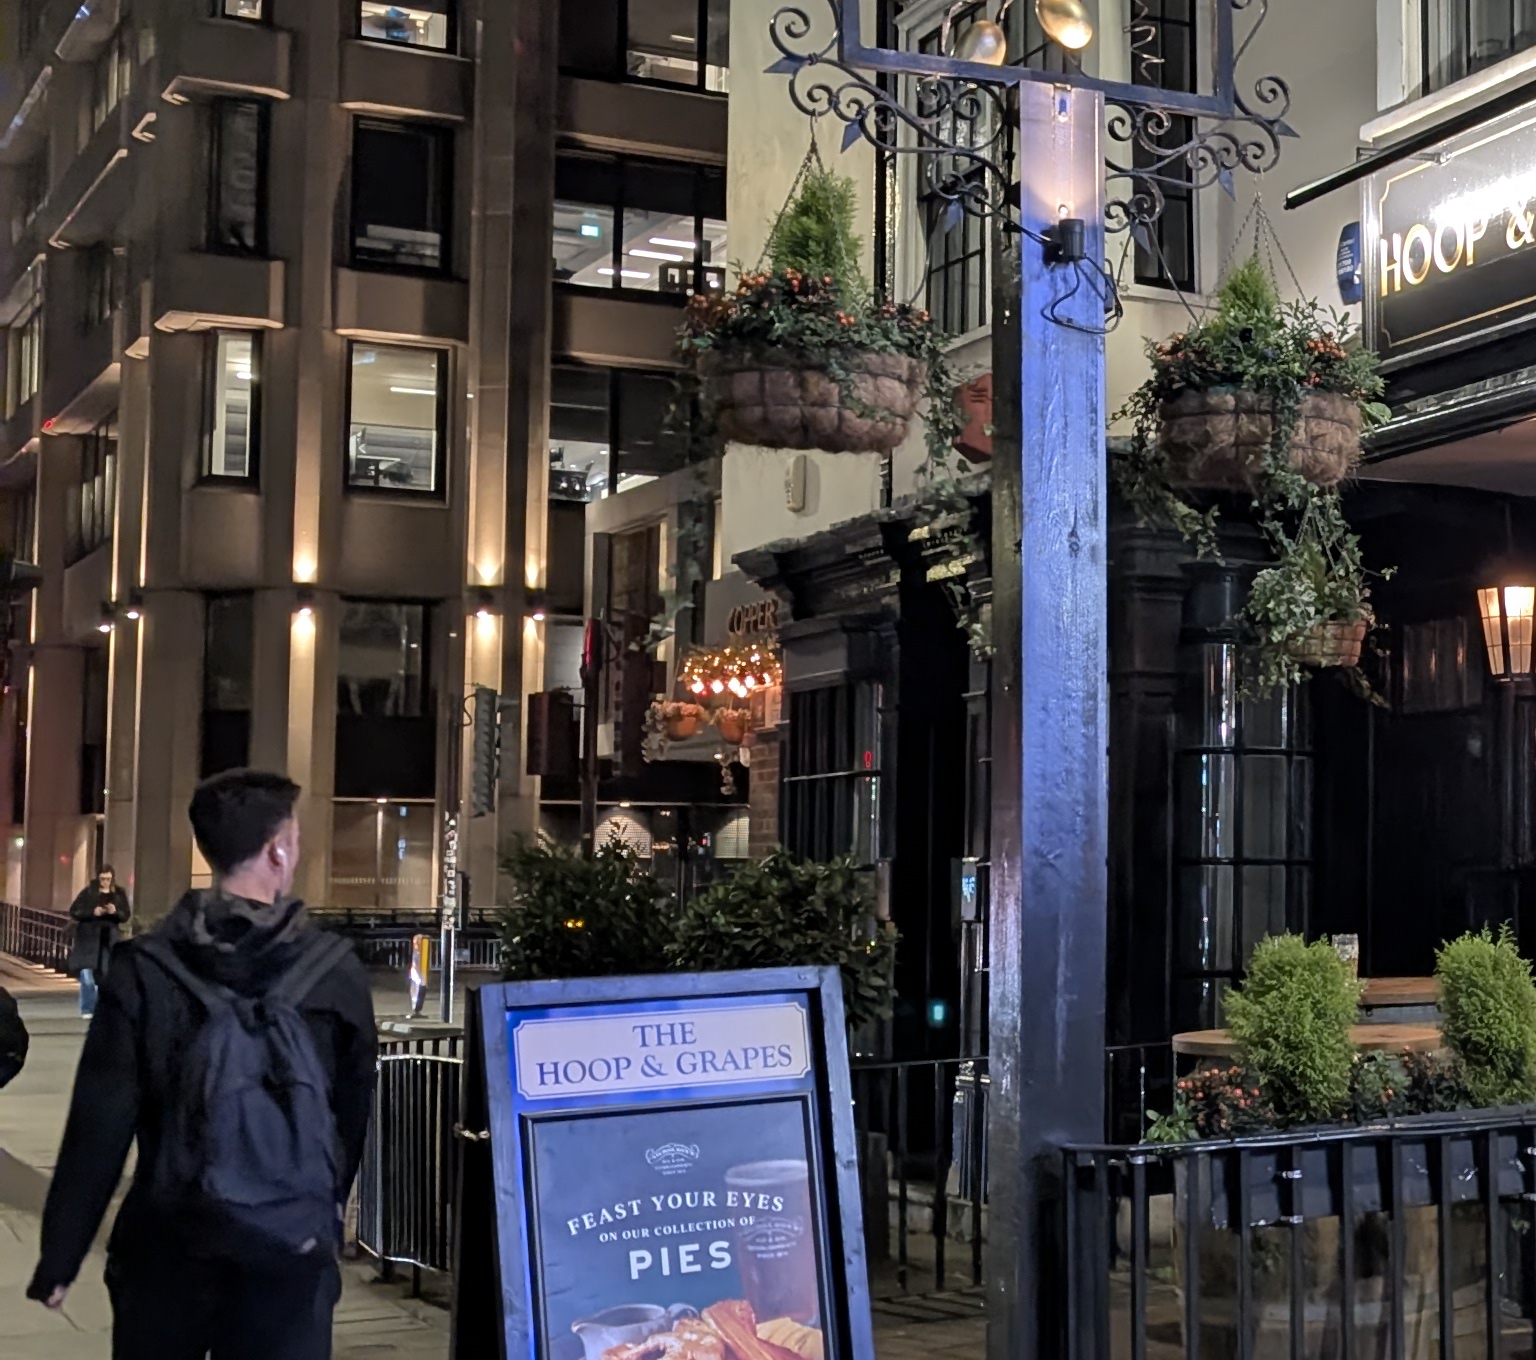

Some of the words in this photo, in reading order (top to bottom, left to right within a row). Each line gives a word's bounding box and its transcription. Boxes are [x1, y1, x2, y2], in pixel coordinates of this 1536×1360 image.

[1380, 212, 1488, 298] HOOP
[1505, 200, 1536, 250] &
[632, 1021, 697, 1048] THE
[536, 1056, 632, 1086] HOOP
[640, 1054, 668, 1078] &
[676, 1044, 793, 1075] GRAPES
[567, 1199, 642, 1236] FEAST
[651, 1191, 717, 1212] YOUR
[726, 1191, 785, 1212] EYES
[599, 1231, 618, 1243] ON
[622, 1227, 650, 1240] OUR
[653, 1219, 736, 1237] COLLECTION
[739, 1216, 757, 1226] OF
[628, 1240, 732, 1280] PIES
